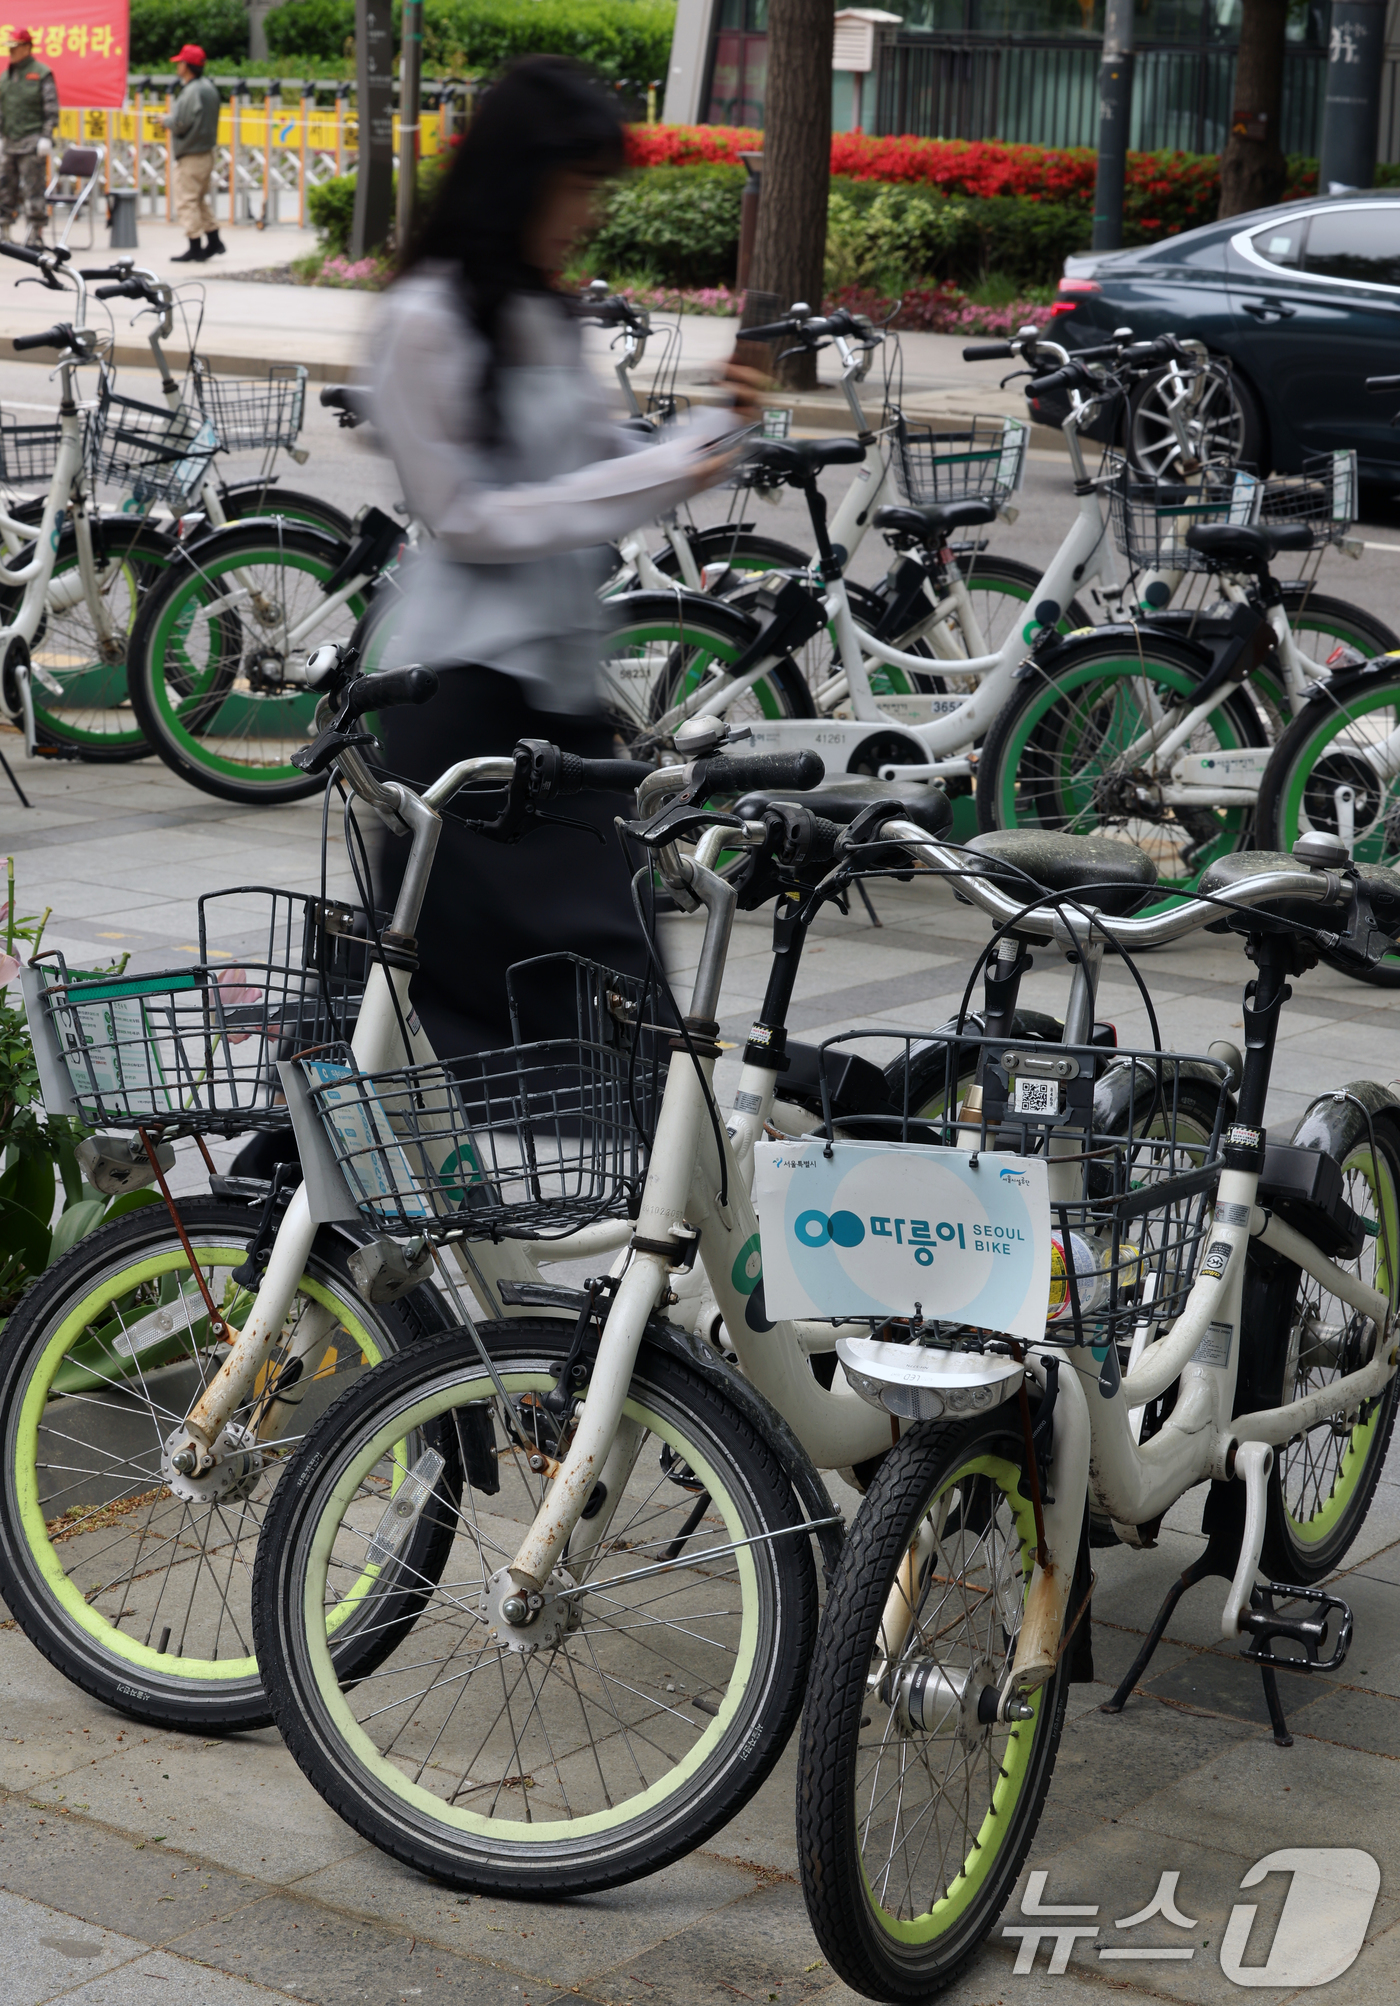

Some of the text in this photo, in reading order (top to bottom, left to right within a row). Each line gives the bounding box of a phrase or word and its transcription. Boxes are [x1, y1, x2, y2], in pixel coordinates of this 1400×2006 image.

[815, 733, 846, 744] 41261
[783, 1160, 817, 1169] 서울특별시
[1002, 1174, 1031, 1187] 서울시설공단
[972, 1224, 1025, 1242] SEOUL
[870, 1216, 966, 1267] 따릉이
[974, 1240, 1012, 1256] BIKE
[903, 1373, 921, 1382] LED
